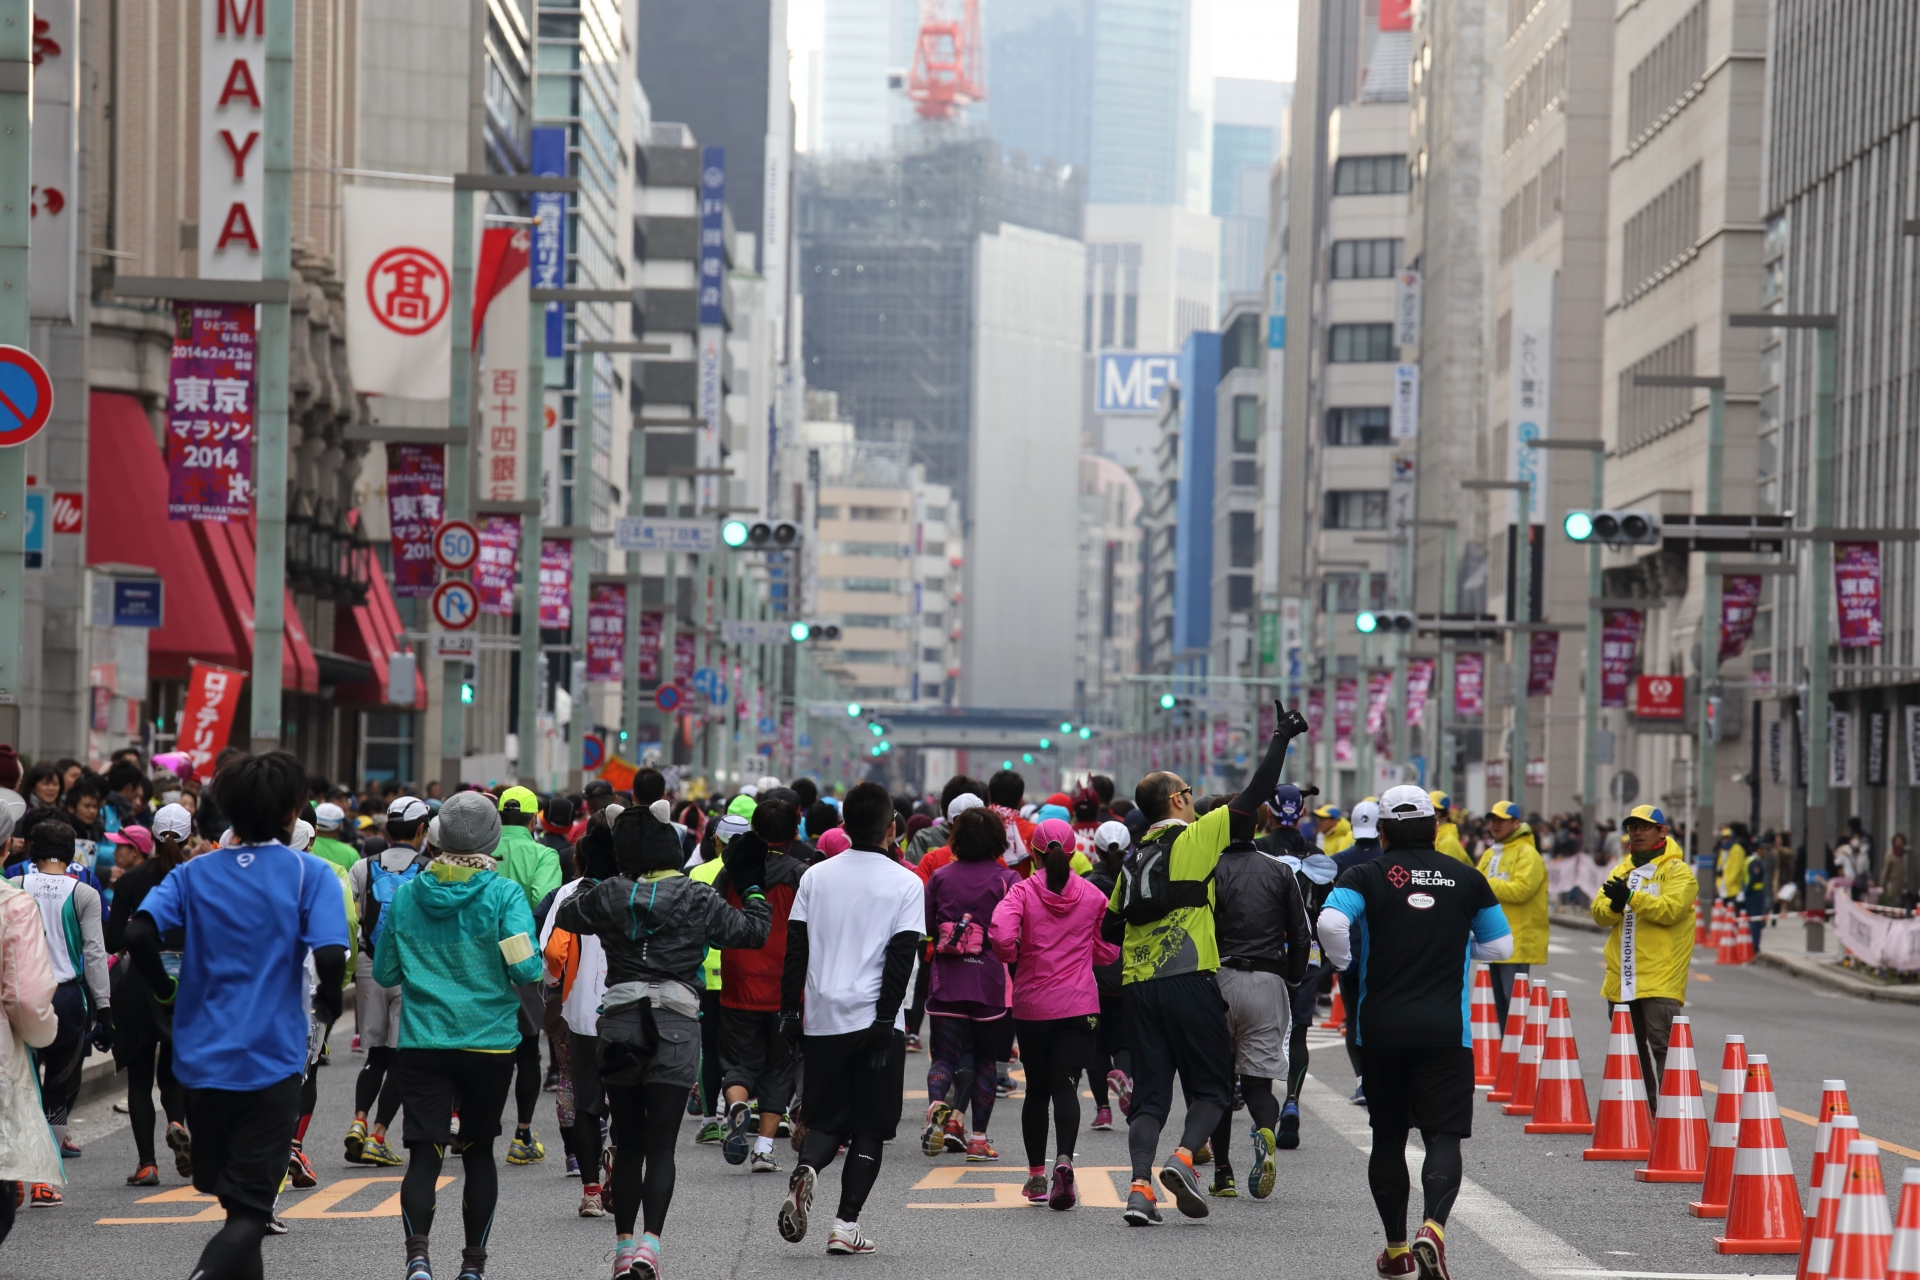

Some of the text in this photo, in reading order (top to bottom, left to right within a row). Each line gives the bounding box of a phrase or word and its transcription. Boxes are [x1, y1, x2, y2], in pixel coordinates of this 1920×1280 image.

[216, 0, 264, 251] MAYA
[174, 376, 250, 414] 東京
[171, 419, 251, 441] マラソン
[183, 445, 239, 470] 2014
[54, 495, 81, 530] lly
[391, 494, 440, 521] 東京
[403, 542, 432, 560] 201
[444, 533, 471, 558] 50
[188, 671, 229, 770] ロッテリア
[1835, 717, 1846, 782] MARUZEN
[1869, 713, 1884, 783] MARUZEN
[1411, 869, 1442, 878] SET A
[1411, 878, 1455, 887] RECORD
[1629, 872, 1641, 890] TOK
[1623, 964, 1632, 986] 2014
